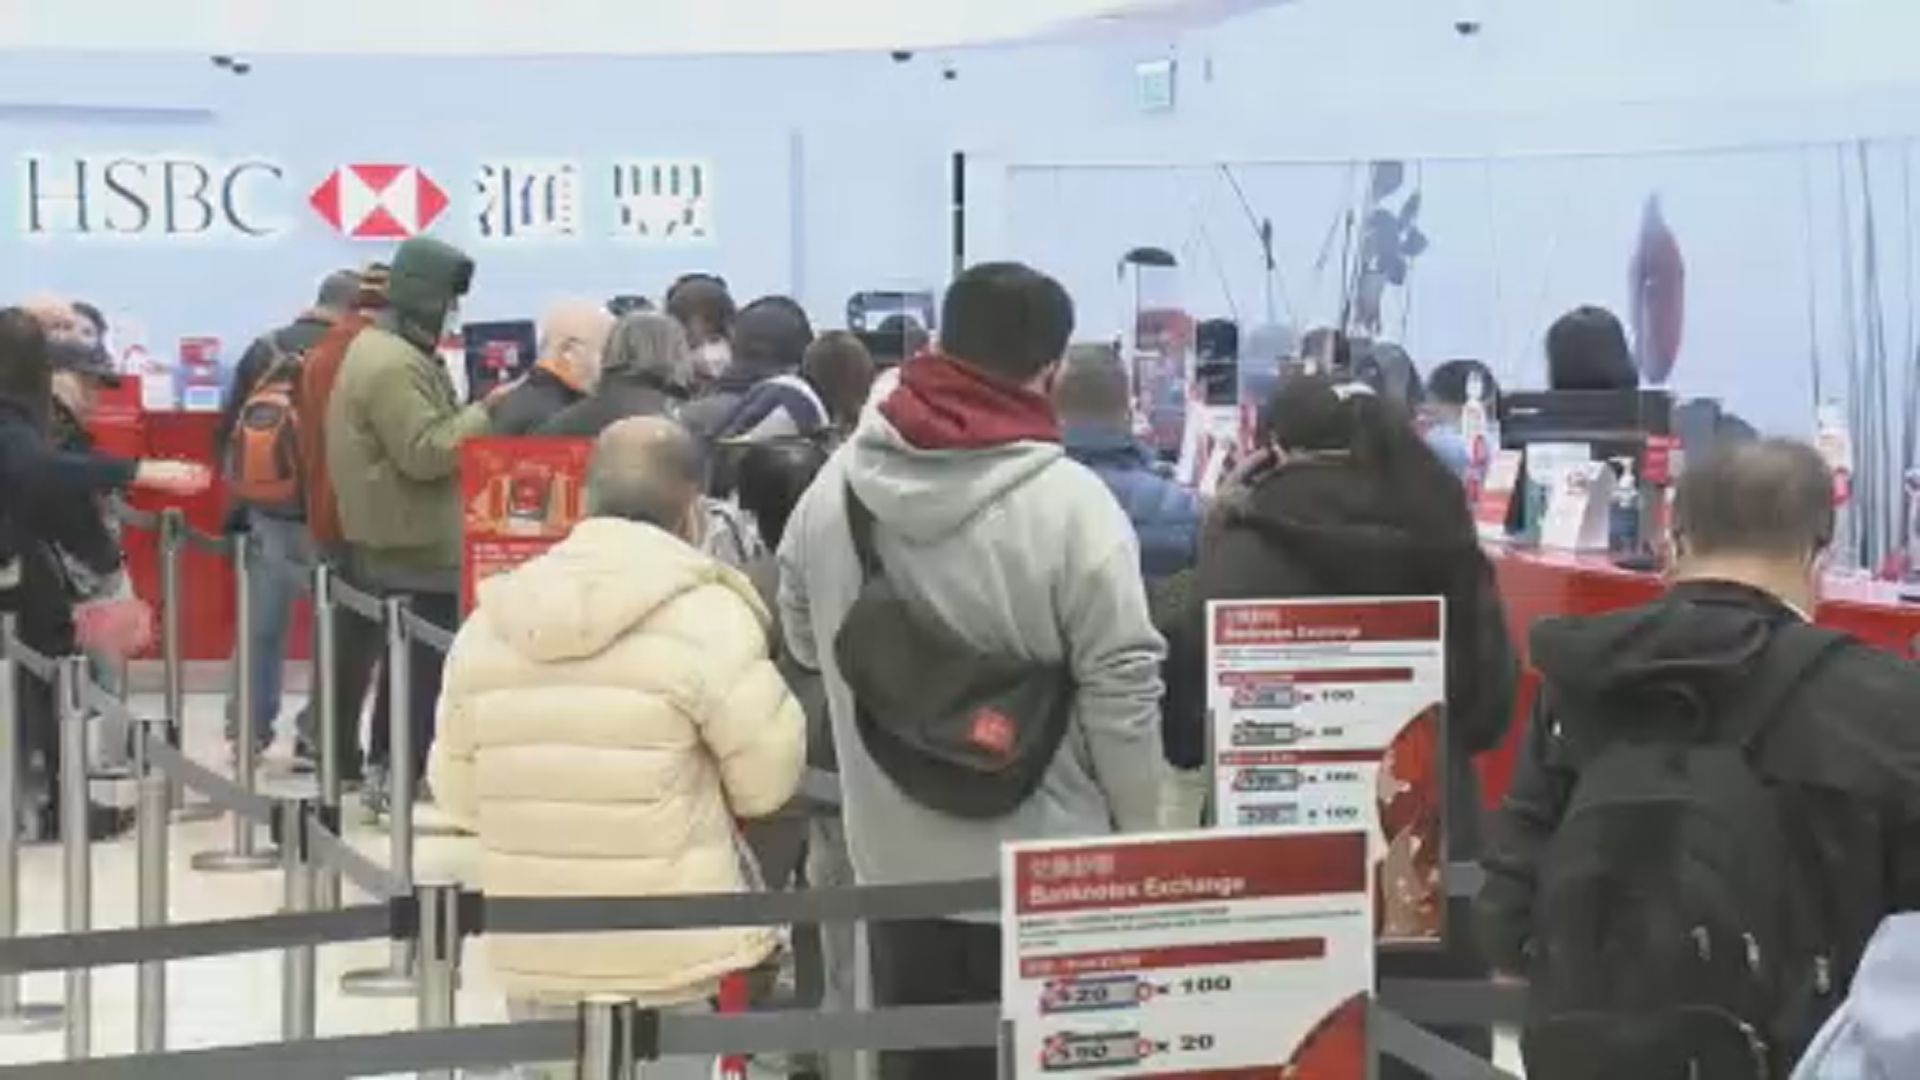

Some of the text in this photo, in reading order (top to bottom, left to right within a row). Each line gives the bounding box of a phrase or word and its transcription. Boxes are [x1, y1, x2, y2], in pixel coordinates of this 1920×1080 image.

[27, 159, 284, 236] HSBC
[1029, 875, 1247, 905] Banknotes Exchange
[1179, 976, 1232, 994] 100
[1179, 1033, 1215, 1050] 20
